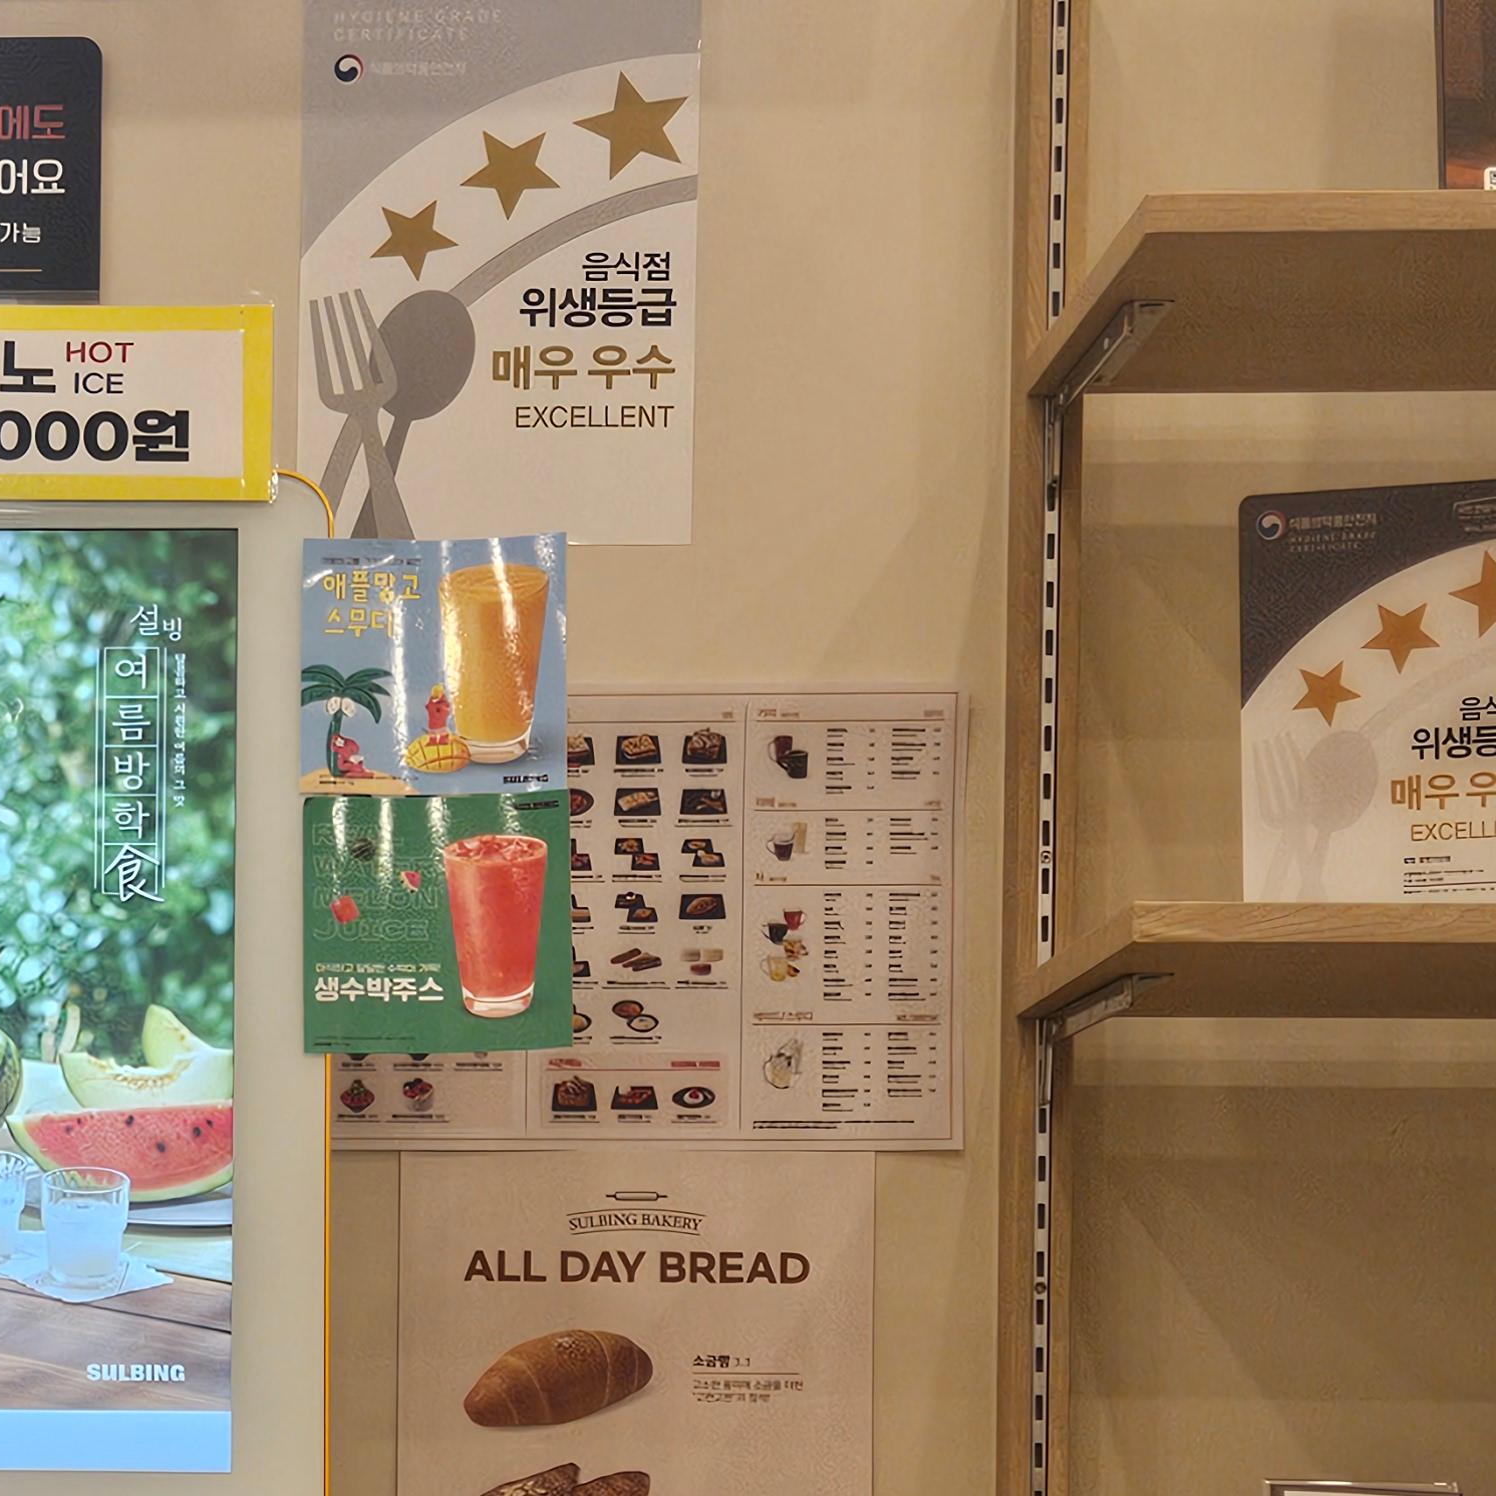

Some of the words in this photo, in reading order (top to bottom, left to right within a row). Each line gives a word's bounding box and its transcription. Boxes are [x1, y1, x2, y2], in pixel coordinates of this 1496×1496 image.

[582, 251, 672, 283] 음식점
[519, 287, 678, 328] 위생등급
[65, 341, 135, 364] HOT
[492, 345, 577, 391] 매우
[588, 344, 676, 390] 우수
[72, 373, 125, 396] ICE
[515, 404, 675, 430] EXCELLENT
[322, 569, 422, 605] 애플망고
[129, 603, 183, 642] 설빙
[324, 607, 394, 638] 스무디
[1390, 774, 1460, 811] 매우
[314, 976, 445, 1002] 생수박주스
[567, 1212, 638, 1233] SULBING
[640, 1212, 705, 1233] BAKERY
[463, 1249, 547, 1283] ALL
[559, 1250, 647, 1284] DAY
[658, 1251, 811, 1285] BREAD
[85, 1362, 186, 1383] SULBING
